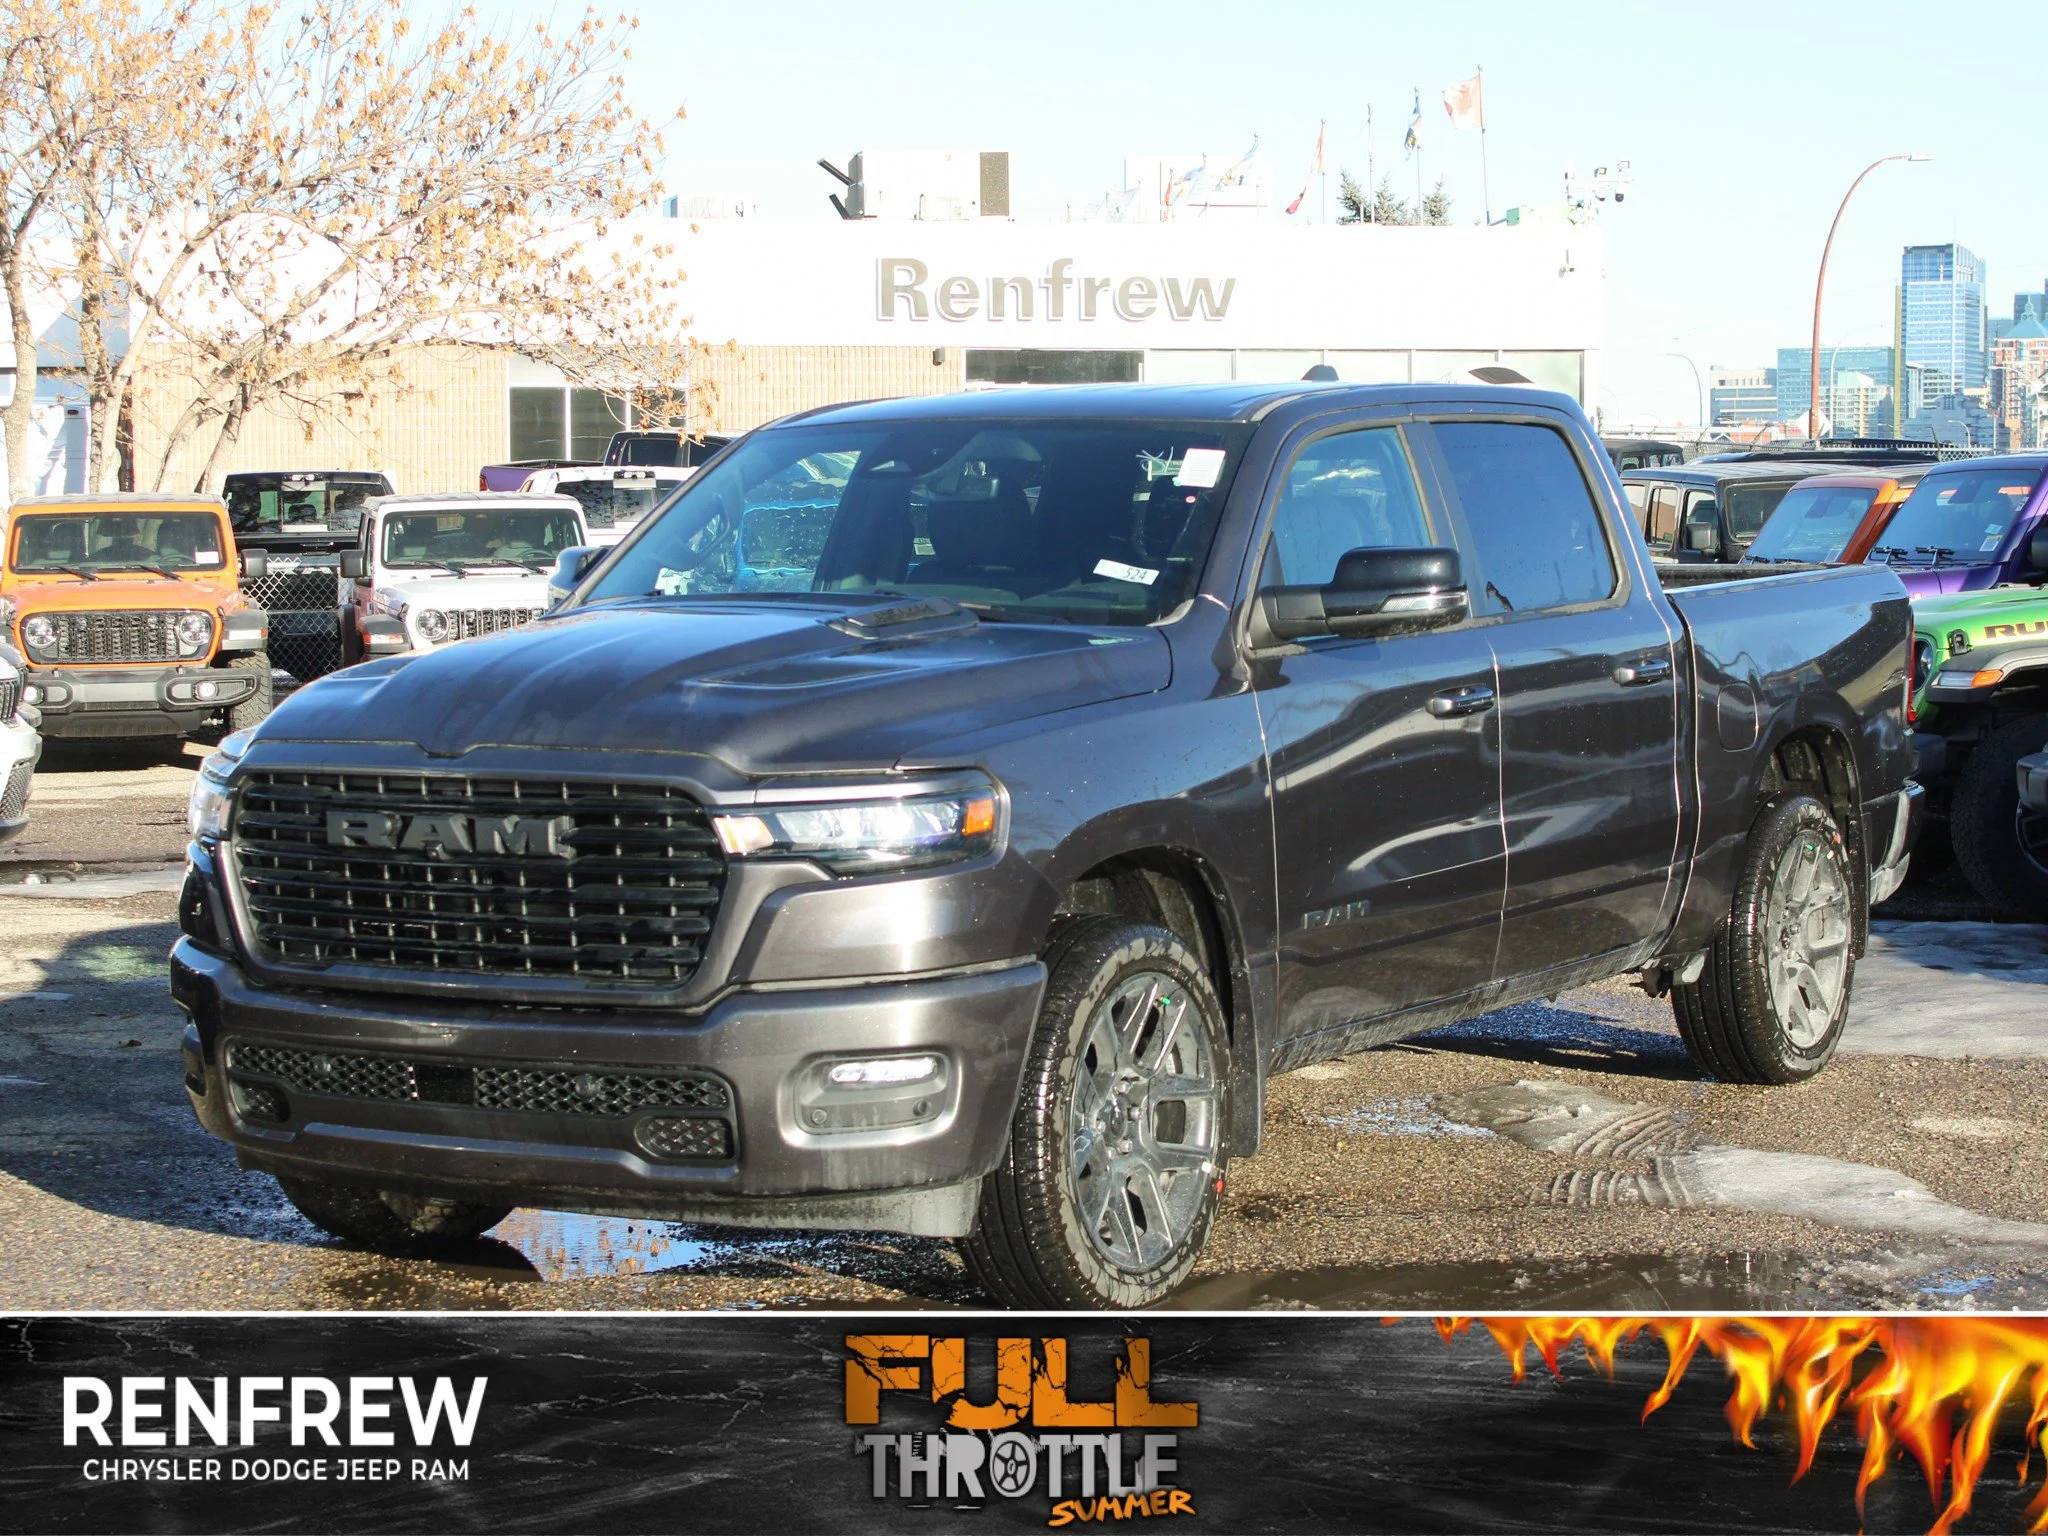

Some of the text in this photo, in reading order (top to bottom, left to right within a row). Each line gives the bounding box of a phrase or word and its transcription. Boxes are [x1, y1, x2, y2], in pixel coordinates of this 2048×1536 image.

[876, 257, 1237, 322] Renfrew
[1984, 621, 2048, 639] RU
[326, 810, 577, 861] RAM
[1302, 900, 1369, 930] RAM
